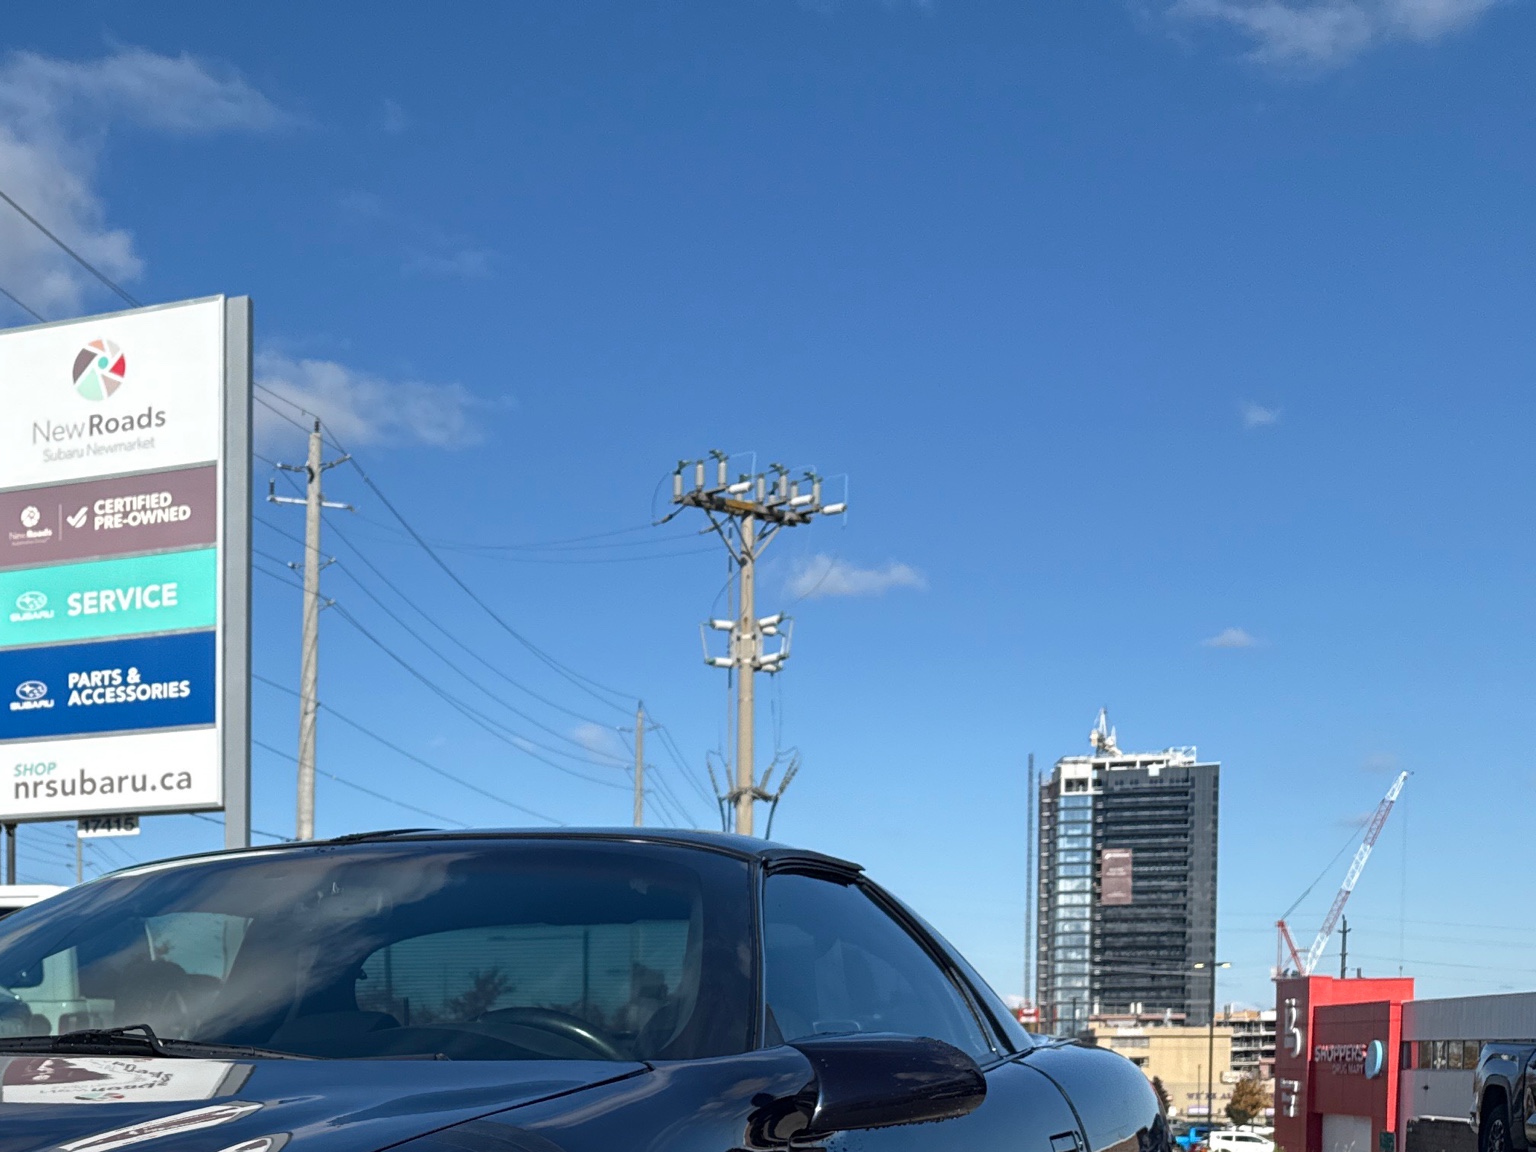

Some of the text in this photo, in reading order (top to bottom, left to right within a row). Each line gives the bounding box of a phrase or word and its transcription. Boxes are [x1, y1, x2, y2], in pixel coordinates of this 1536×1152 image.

[43, 437, 156, 462] Subaru Newmarket
[93, 491, 172, 515] CERTIFIED
[94, 505, 191, 531] PRE-OWNED
[67, 582, 179, 617] SERVICE
[68, 667, 142, 689] PARTS &
[10, 699, 54, 711] SUBARU
[68, 680, 191, 707] ACCESSORIES
[14, 761, 57, 777] SHOP
[14, 769, 192, 799] nrsubaru.ca
[82, 816, 135, 833] 17415
